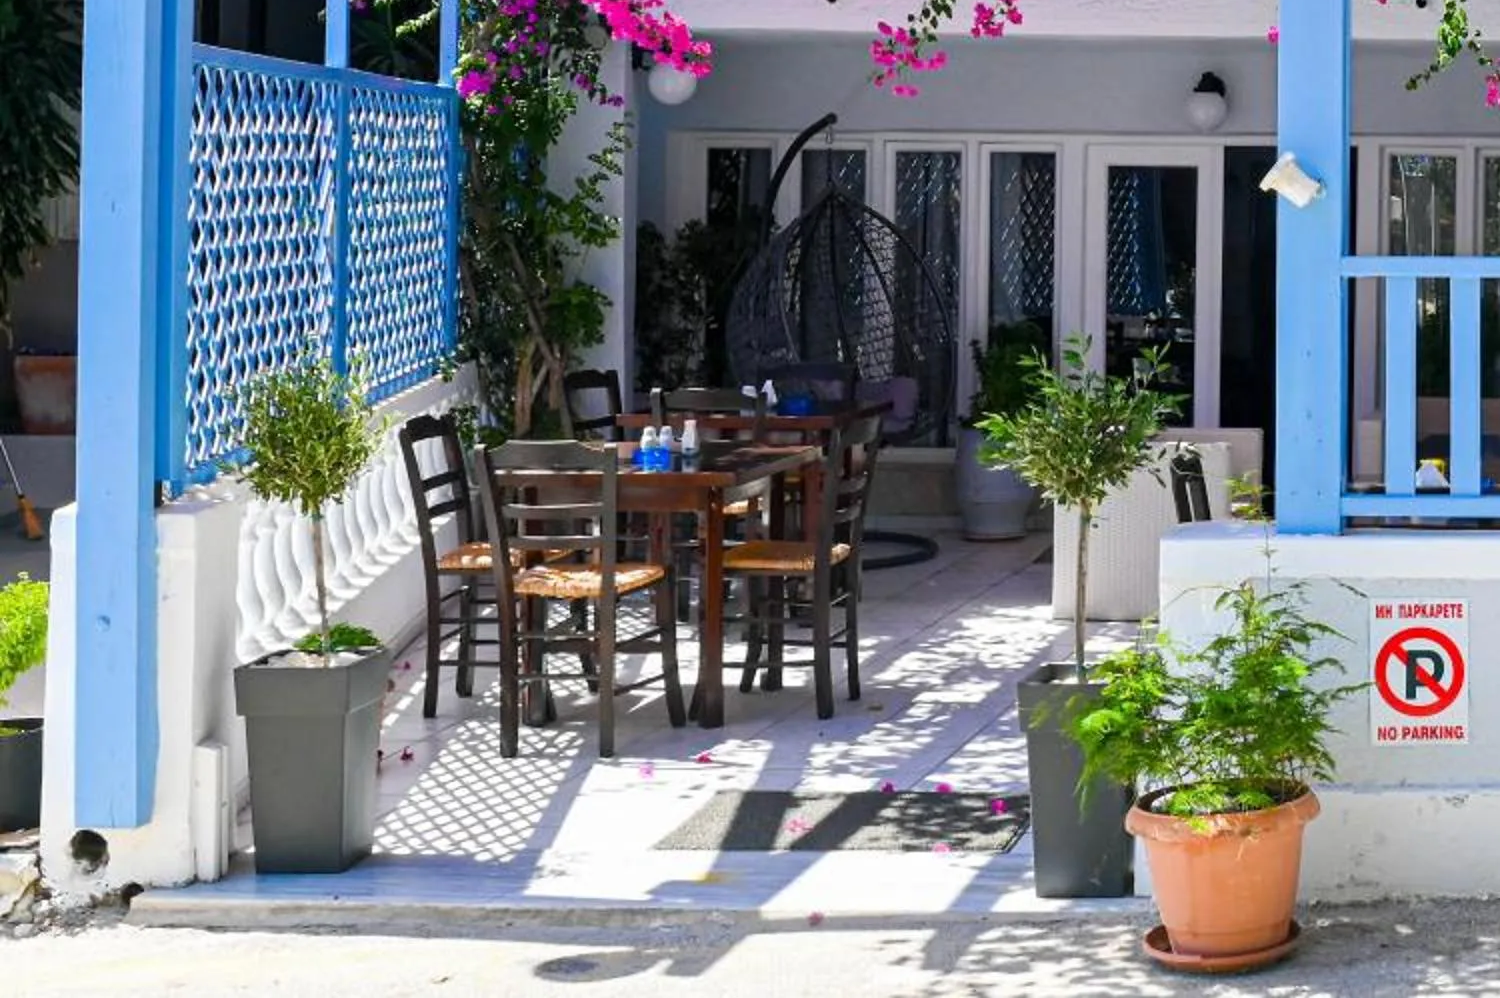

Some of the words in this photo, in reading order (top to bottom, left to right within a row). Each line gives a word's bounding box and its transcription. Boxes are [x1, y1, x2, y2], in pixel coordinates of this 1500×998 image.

[1375, 604, 1393, 618] ΜΗ
[1398, 603, 1464, 619] ΠΑΡΚΑΡΕΤΕ
[1405, 649, 1445, 700] P
[1377, 727, 1397, 741] NO
[1401, 725, 1465, 740] PARKING
